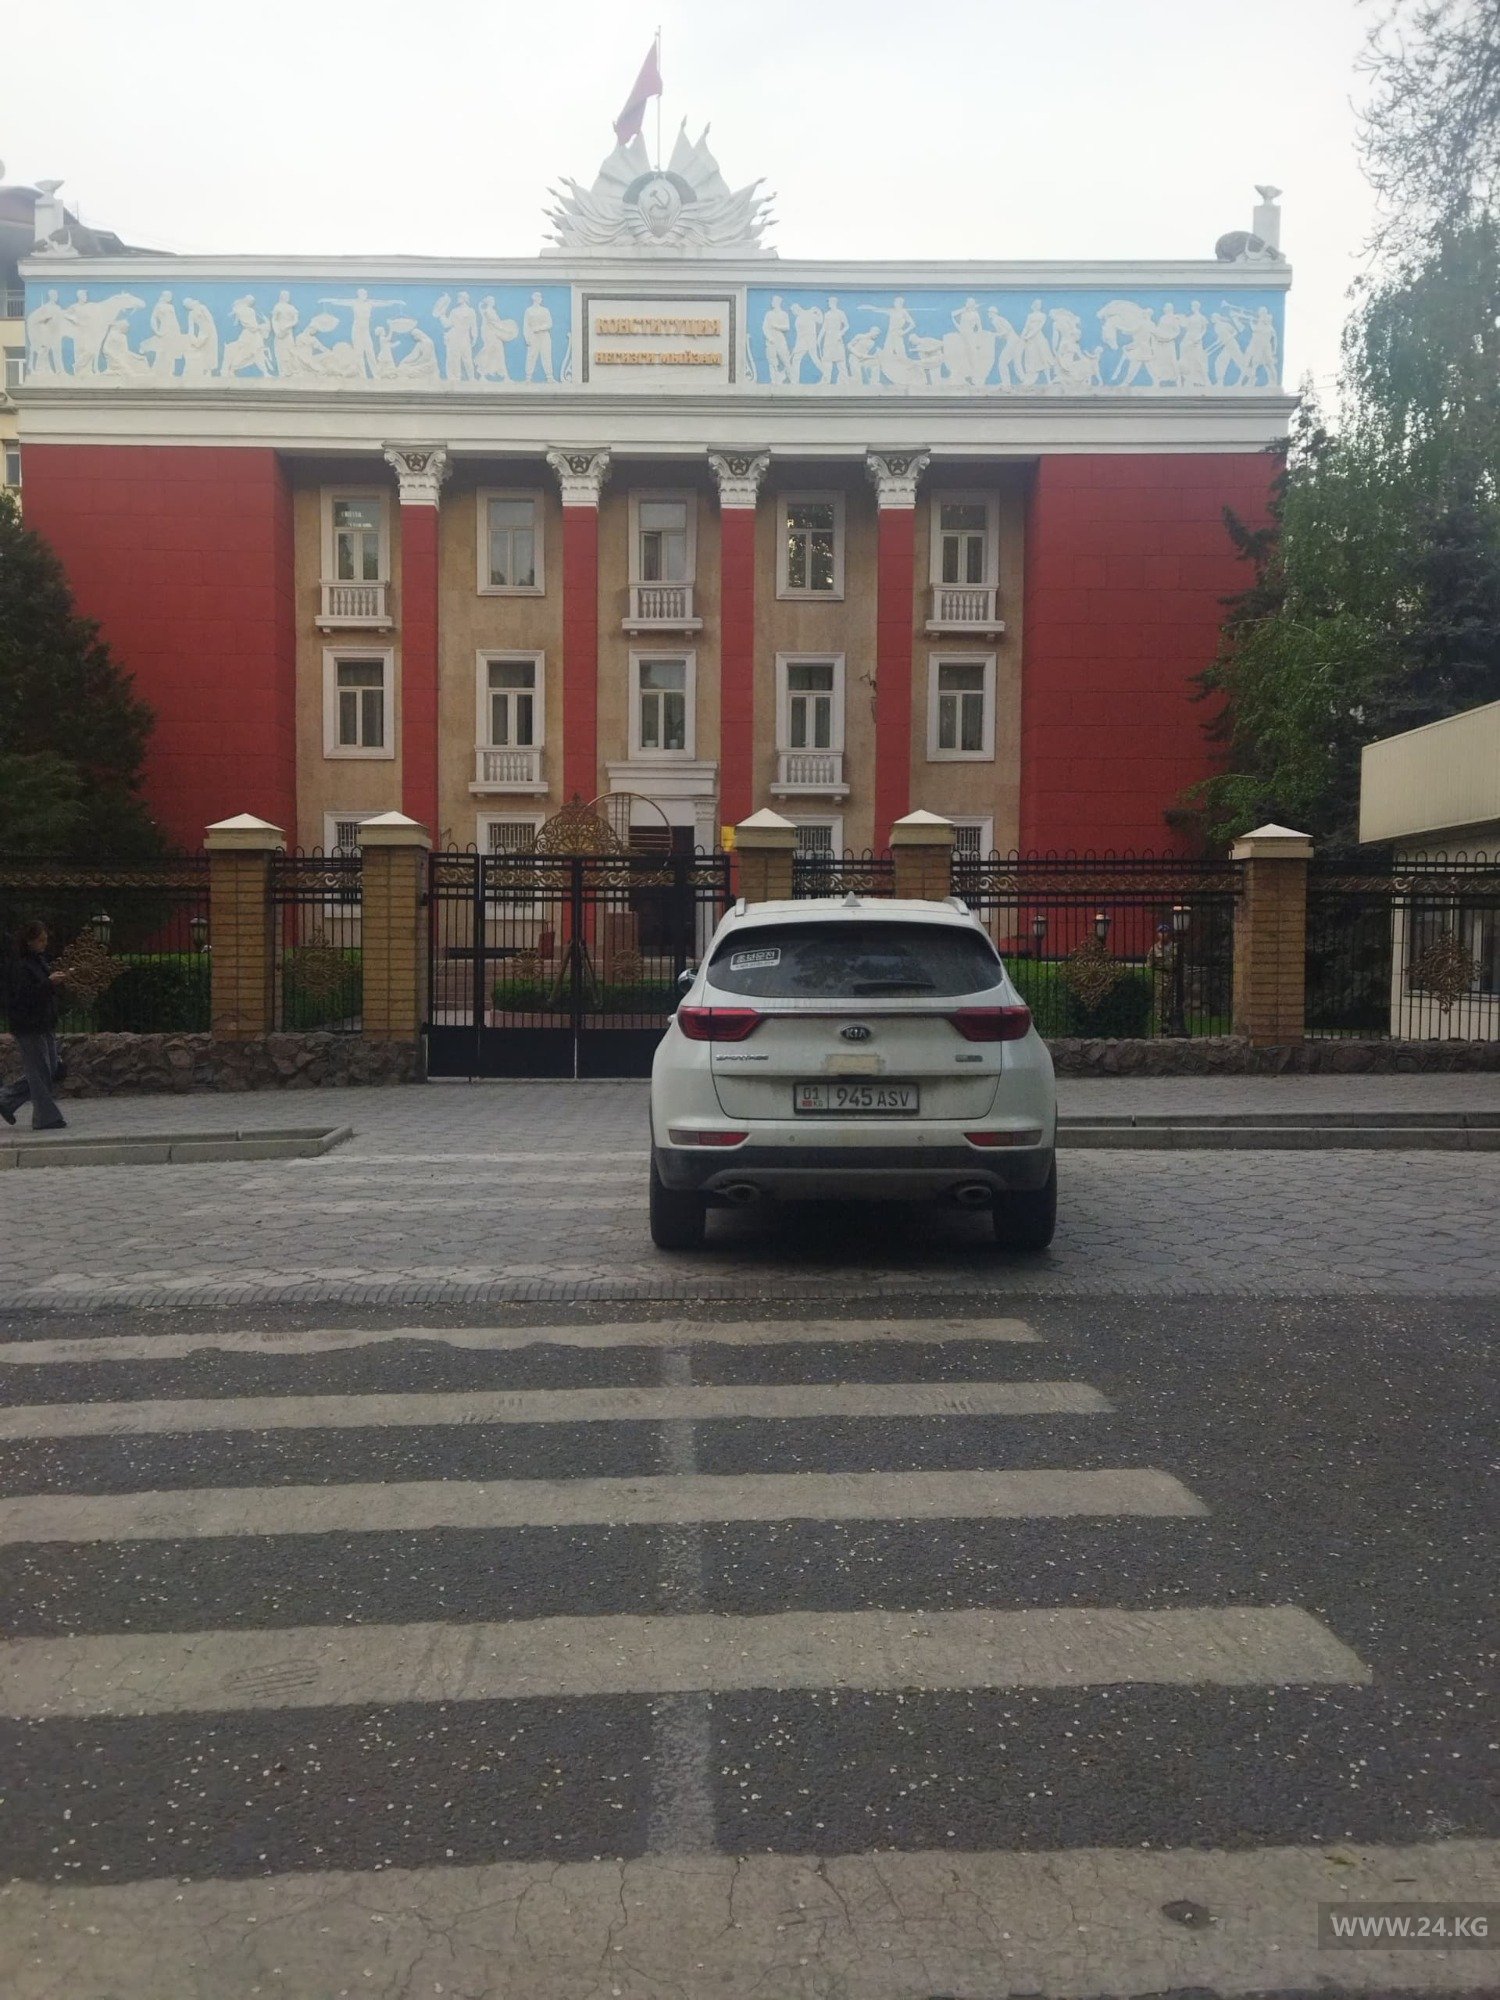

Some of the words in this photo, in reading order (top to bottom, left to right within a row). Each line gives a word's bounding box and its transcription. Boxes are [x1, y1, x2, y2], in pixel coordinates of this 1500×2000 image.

[595, 317, 721, 337] КОНСТИТУЦИЯ
[660, 349, 721, 366] МЫЙЗАМ
[845, 1028, 868, 1038] KIA
[802, 1087, 819, 1100] 01
[836, 1086, 873, 1107] 945
[877, 1090, 909, 1107] ASV
